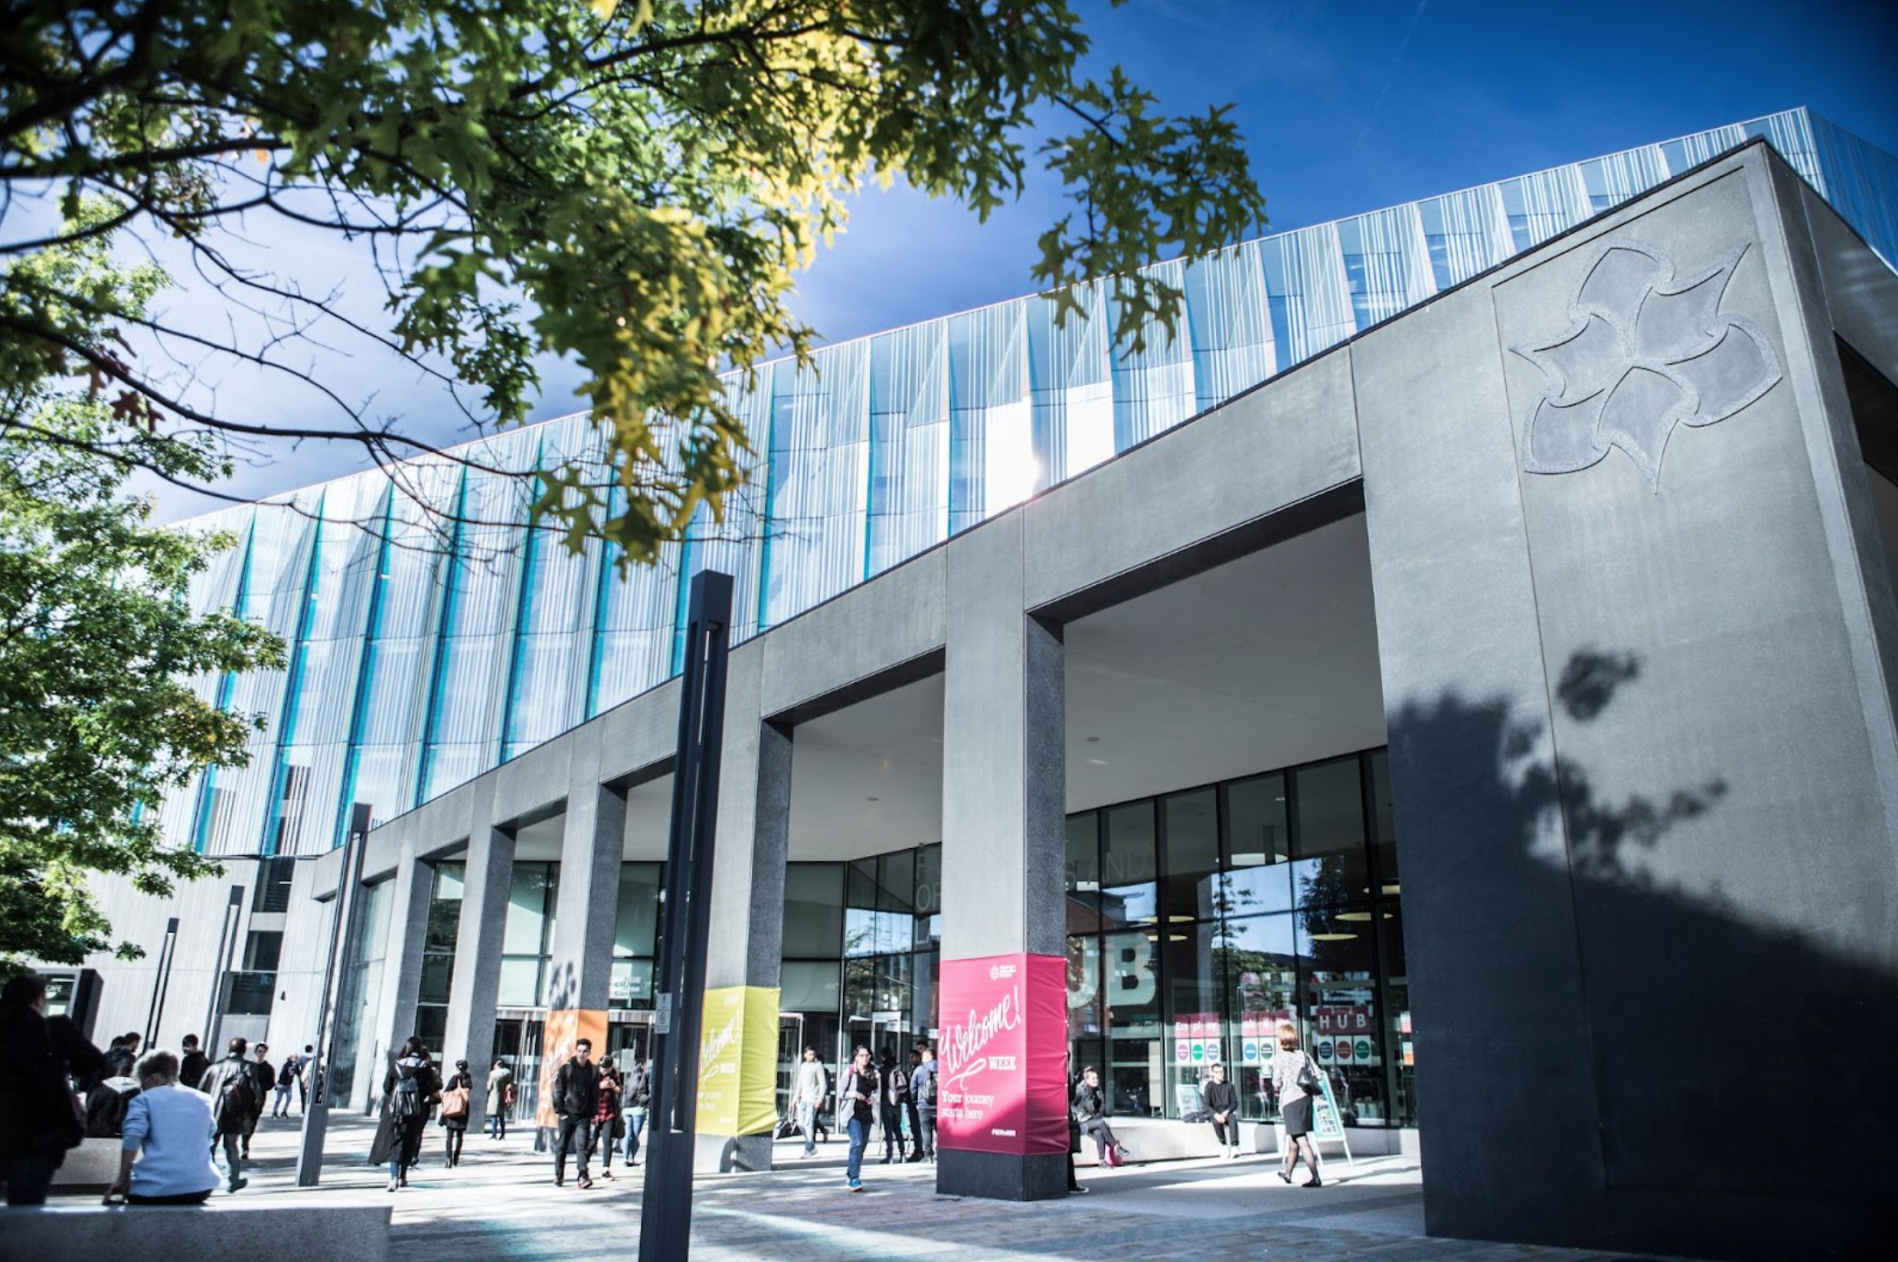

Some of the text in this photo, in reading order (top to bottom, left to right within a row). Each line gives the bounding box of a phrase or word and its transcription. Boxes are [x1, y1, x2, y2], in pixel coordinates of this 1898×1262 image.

[1066, 932, 1156, 1009] UB
[1319, 1013, 1366, 1029] HUB
[939, 985, 1021, 1074] Welcome!
[988, 1056, 1017, 1071] WEEK
[942, 1091, 994, 1107] Your journey
